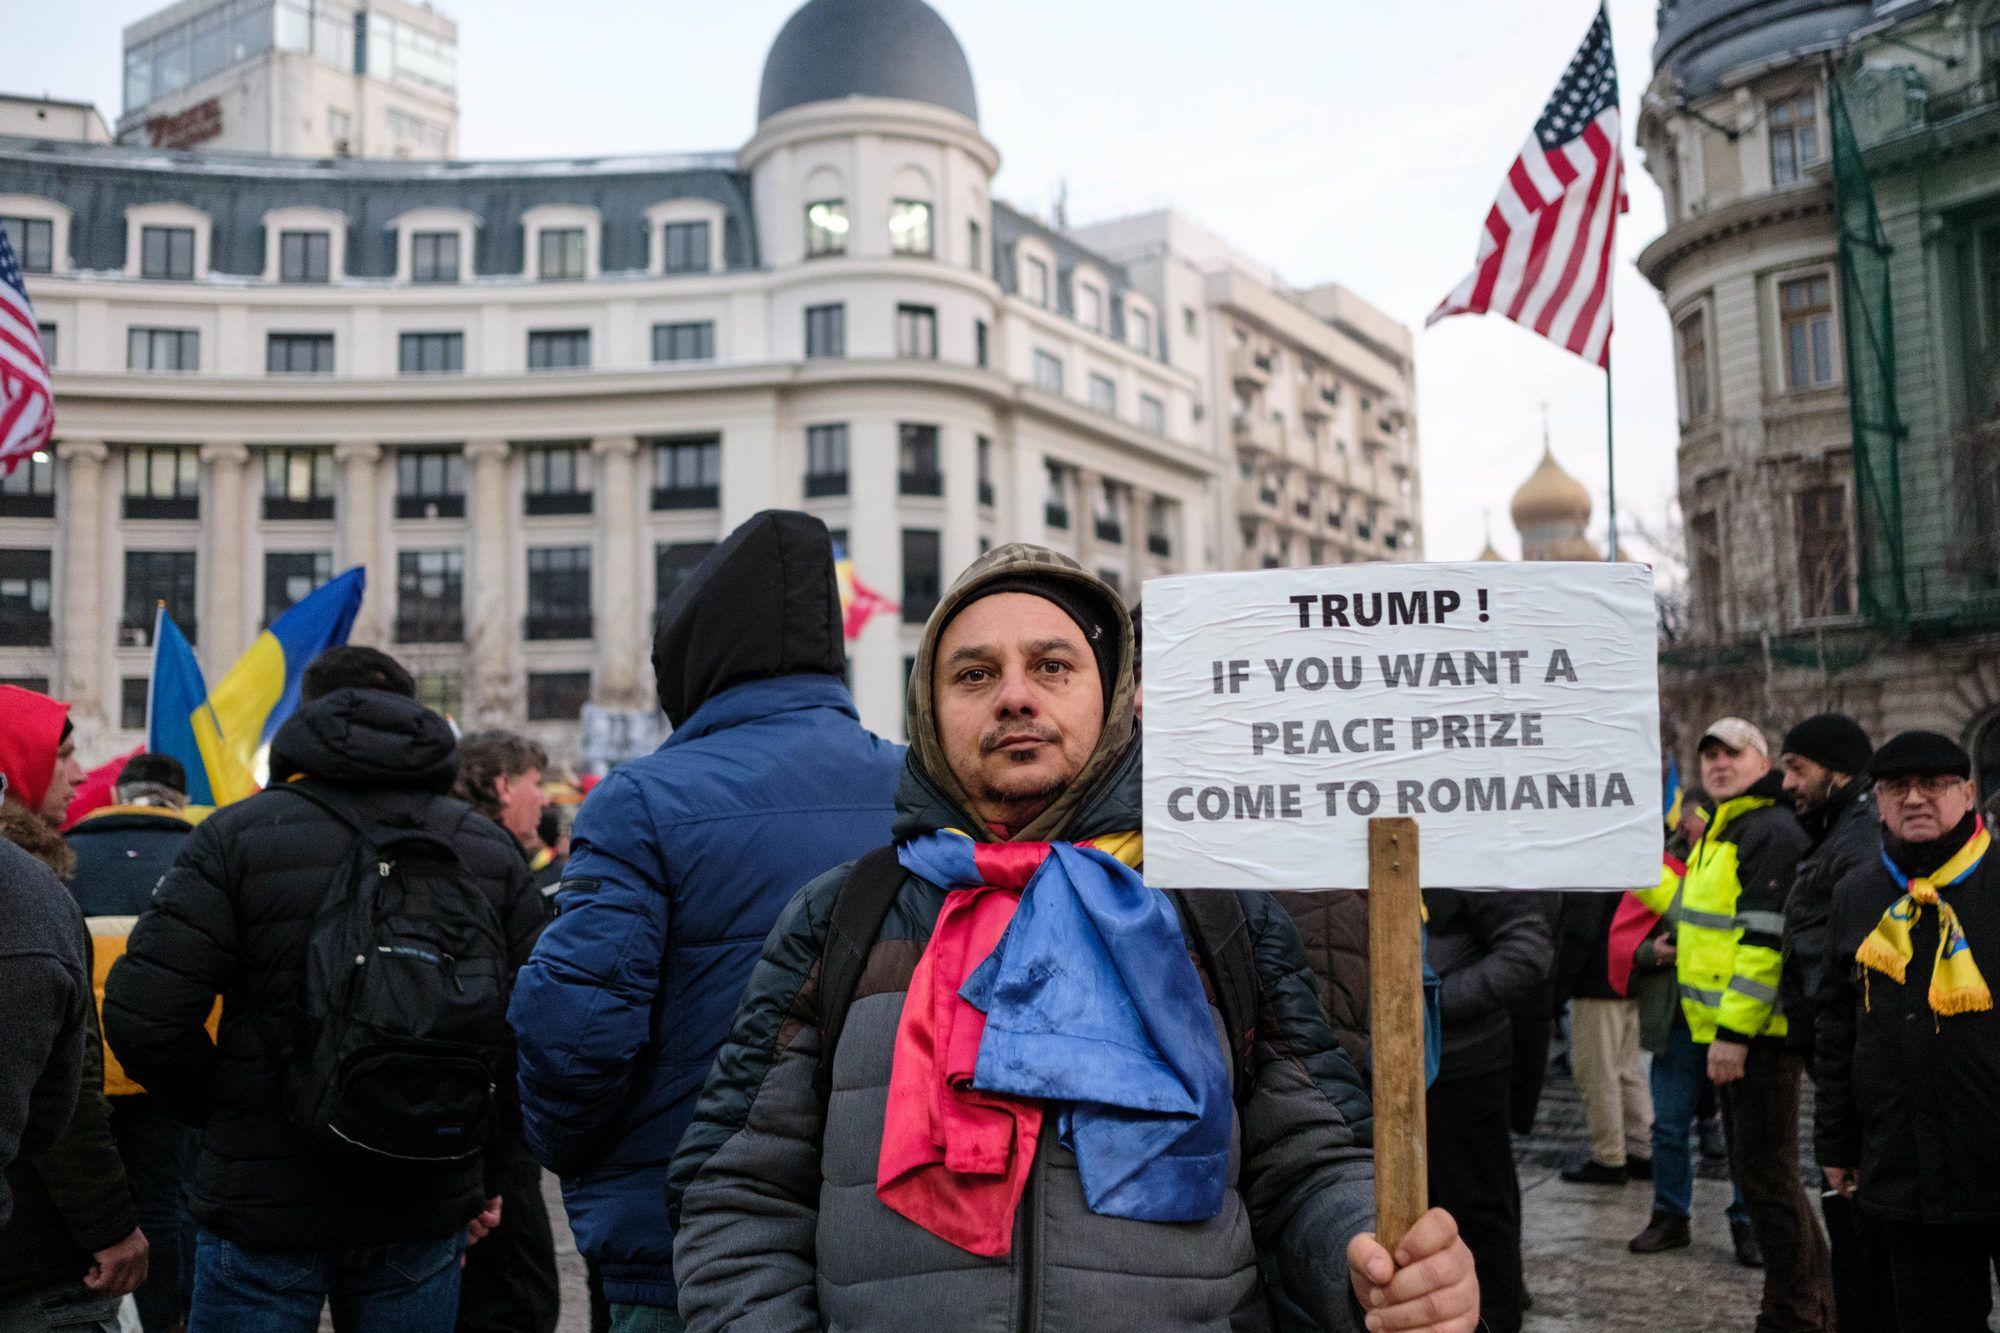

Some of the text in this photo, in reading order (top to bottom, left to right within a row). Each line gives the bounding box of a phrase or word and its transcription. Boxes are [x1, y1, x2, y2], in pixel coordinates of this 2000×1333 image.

[1289, 588, 1490, 629] TRUMP !
[1212, 649, 1578, 694] IF YOU WANT A
[1252, 713, 1544, 755] PEACE PRIZE
[1167, 772, 1634, 822] COME TO ROMANIA
